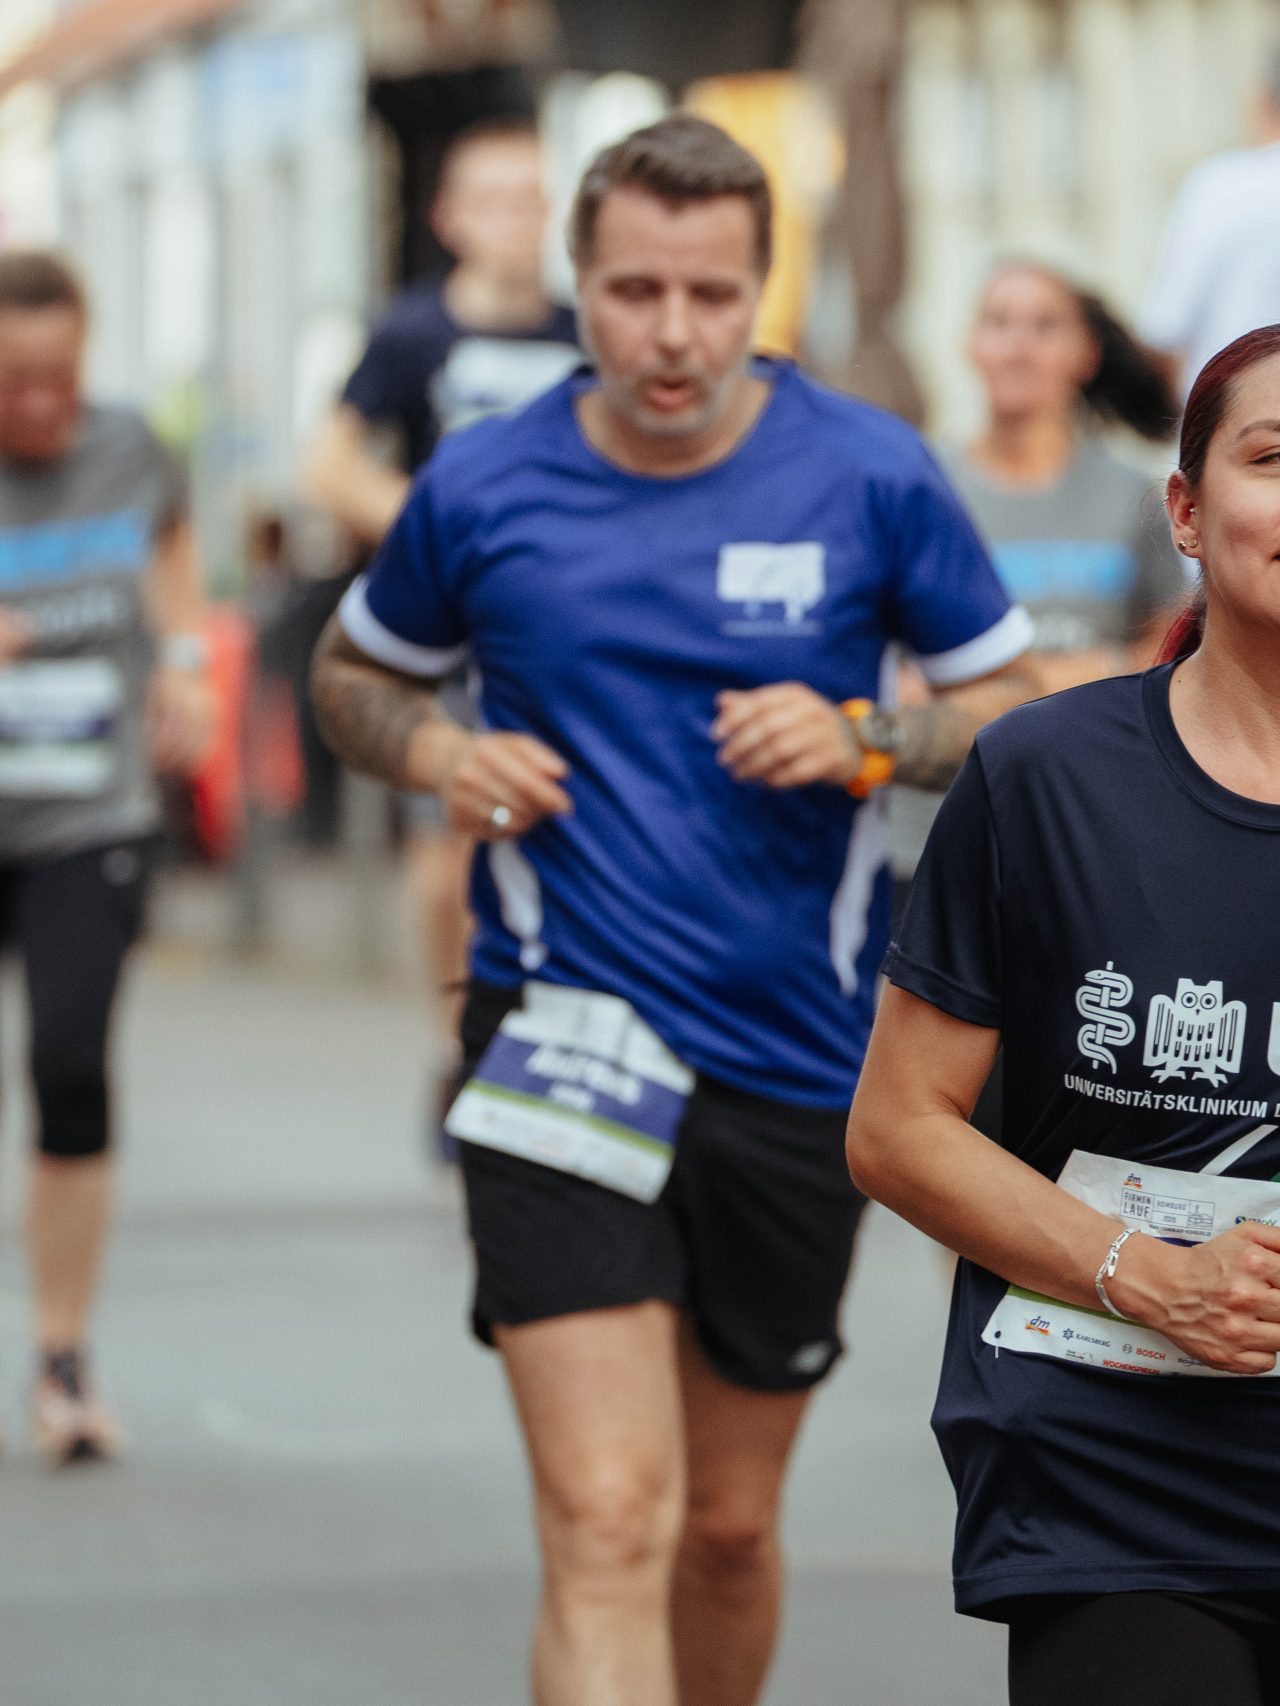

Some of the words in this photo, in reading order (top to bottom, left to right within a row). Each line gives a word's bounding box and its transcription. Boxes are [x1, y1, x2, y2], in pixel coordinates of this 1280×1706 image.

[1124, 1192, 1151, 1205] FIRMEN
[1123, 1202, 1150, 1218] LAUF
[1075, 1333, 1112, 1348] KARLSBERG
[1135, 1347, 1167, 1361] BOSCH
